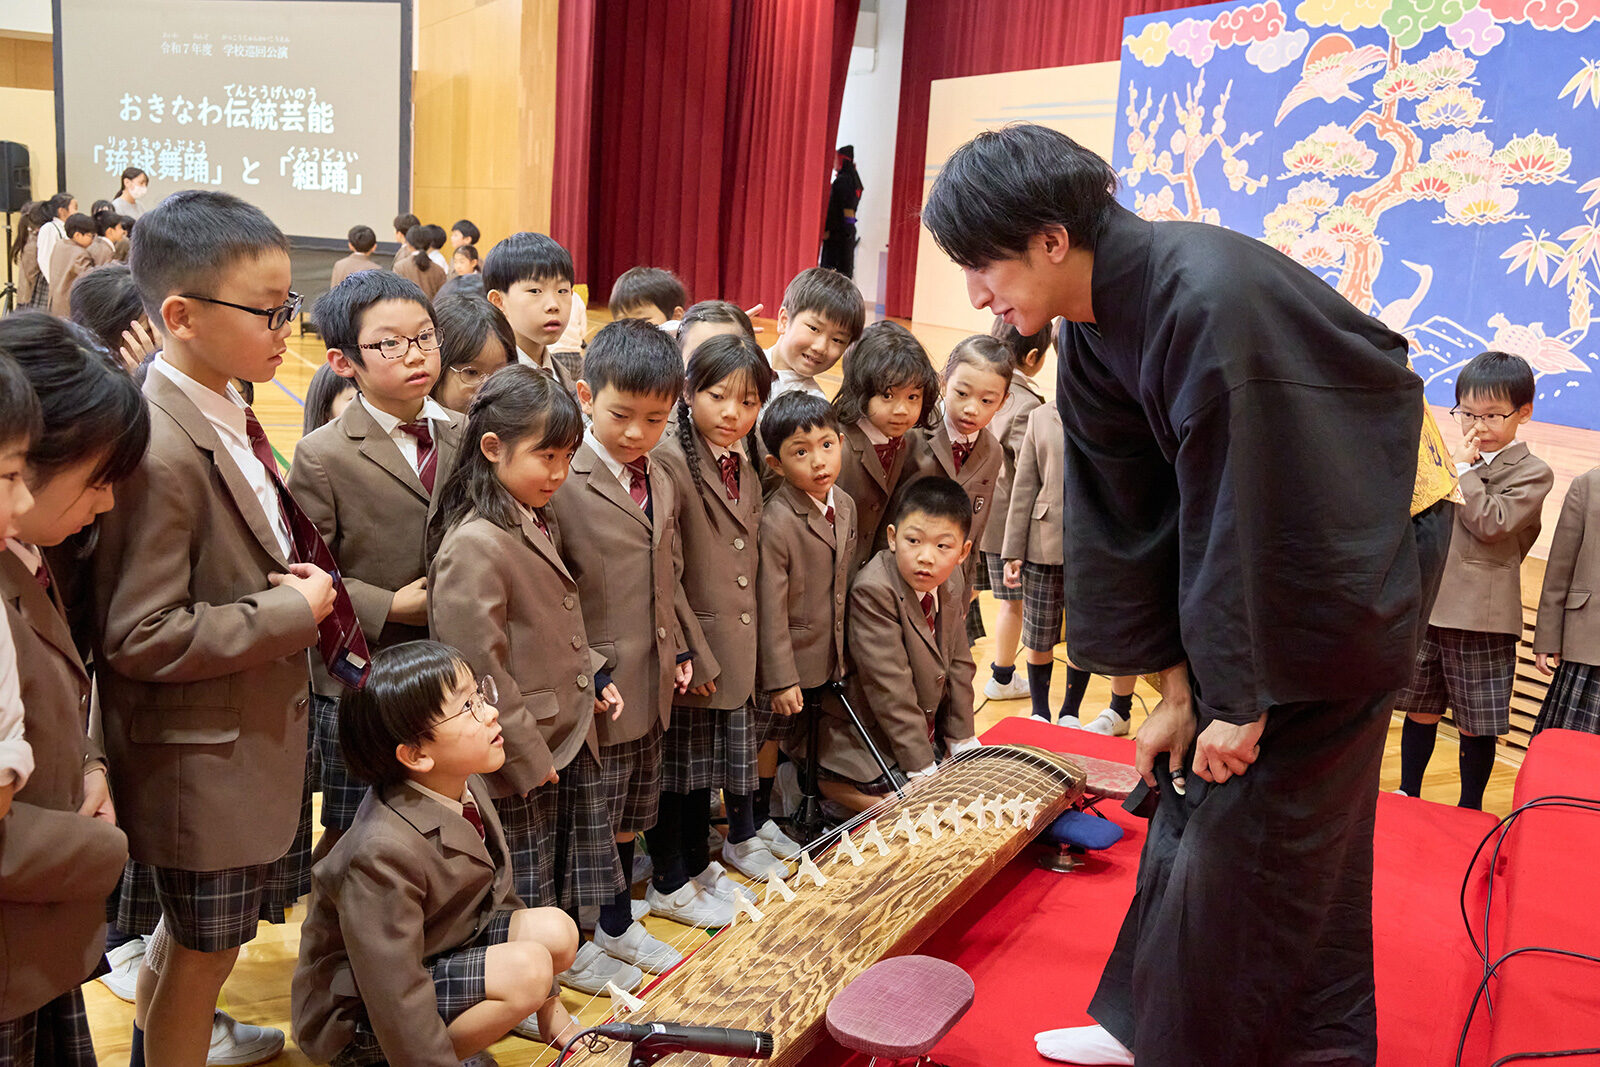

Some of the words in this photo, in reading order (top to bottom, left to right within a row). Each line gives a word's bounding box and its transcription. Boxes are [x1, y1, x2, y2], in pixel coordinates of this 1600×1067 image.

[223, 83, 317, 100] でんとうげいのう
[119, 93, 334, 133] おきなわ伝統芸能
[107, 136, 206, 154] りゅうきゅうぶよう
[242, 156, 260, 184] と
